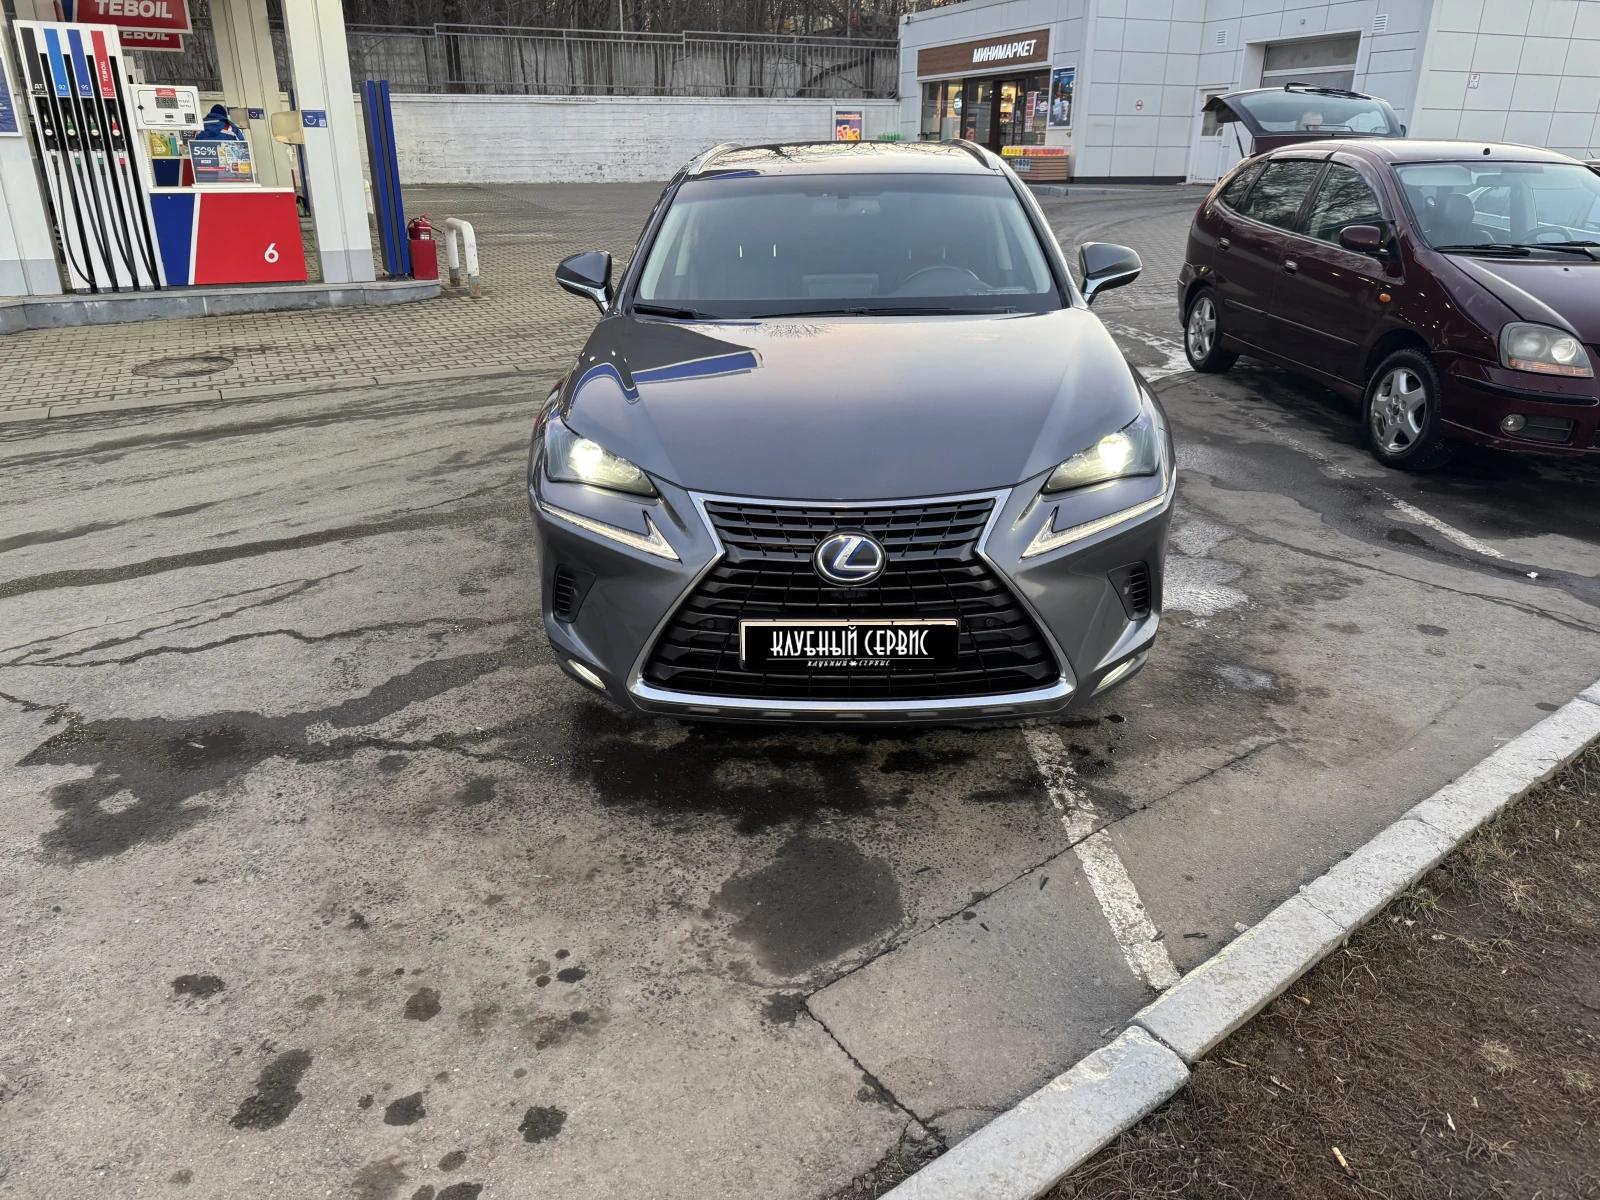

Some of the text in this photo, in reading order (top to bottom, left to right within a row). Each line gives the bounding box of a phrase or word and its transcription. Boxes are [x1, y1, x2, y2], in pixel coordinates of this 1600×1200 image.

[94, 0, 173, 19] TEBOIL
[122, 31, 170, 41] EBOIL
[972, 39, 1037, 64] МИНИМАРКЕТ
[193, 146, 217, 156] 50%
[264, 242, 279, 263] 6
